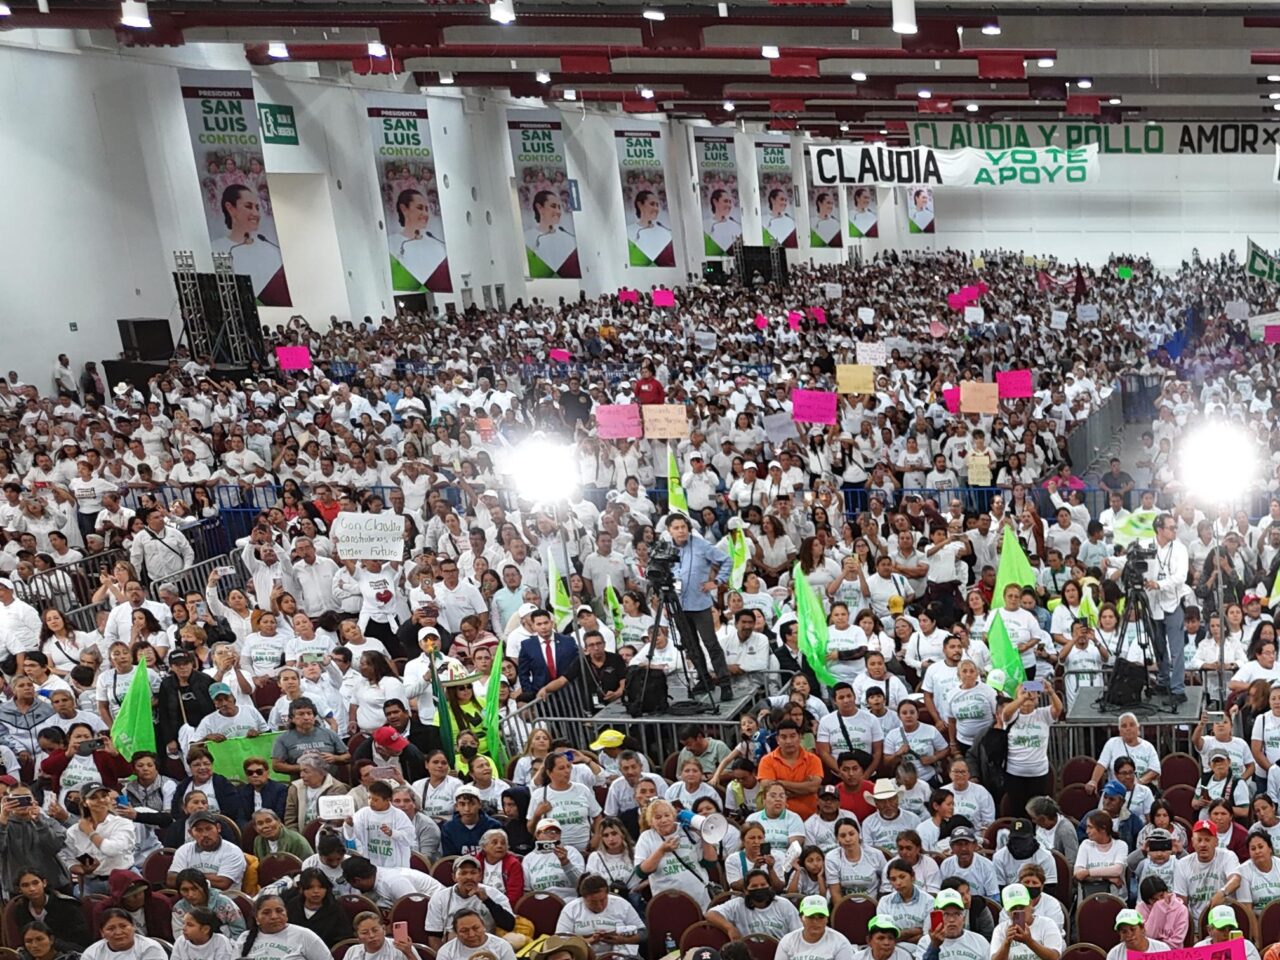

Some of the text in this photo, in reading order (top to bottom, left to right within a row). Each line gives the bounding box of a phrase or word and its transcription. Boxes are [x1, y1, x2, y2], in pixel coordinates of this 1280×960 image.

[198, 90, 241, 98] PRESIDENTA
[200, 100, 243, 116] SAN
[203, 116, 247, 132] LUIS
[383, 118, 418, 132] SAN
[198, 133, 258, 145] CONTIGO
[384, 132, 421, 146] LUIS
[521, 130, 552, 142] SAN
[1039, 124, 1057, 147] Y
[1067, 124, 1163, 154] POLLO
[1179, 123, 1259, 154] AMOR
[522, 141, 554, 154] LUIS
[626, 137, 653, 148] SAN
[704, 143, 728, 152] SAN
[379, 147, 430, 158] CONTIGO
[626, 148, 655, 159] LUIS
[704, 152, 729, 161] LUIS
[762, 148, 784, 156] SAN
[985, 149, 1088, 166] YO TE
[518, 154, 563, 163] CONTIGO
[623, 159, 661, 167] CONTIGO
[764, 156, 786, 164] LUIS
[817, 148, 942, 184] CLAUDIA
[974, 165, 1088, 184] APOYO
[663, 864, 679, 876] SAN
[956, 950, 977, 960] CLAUDIA
